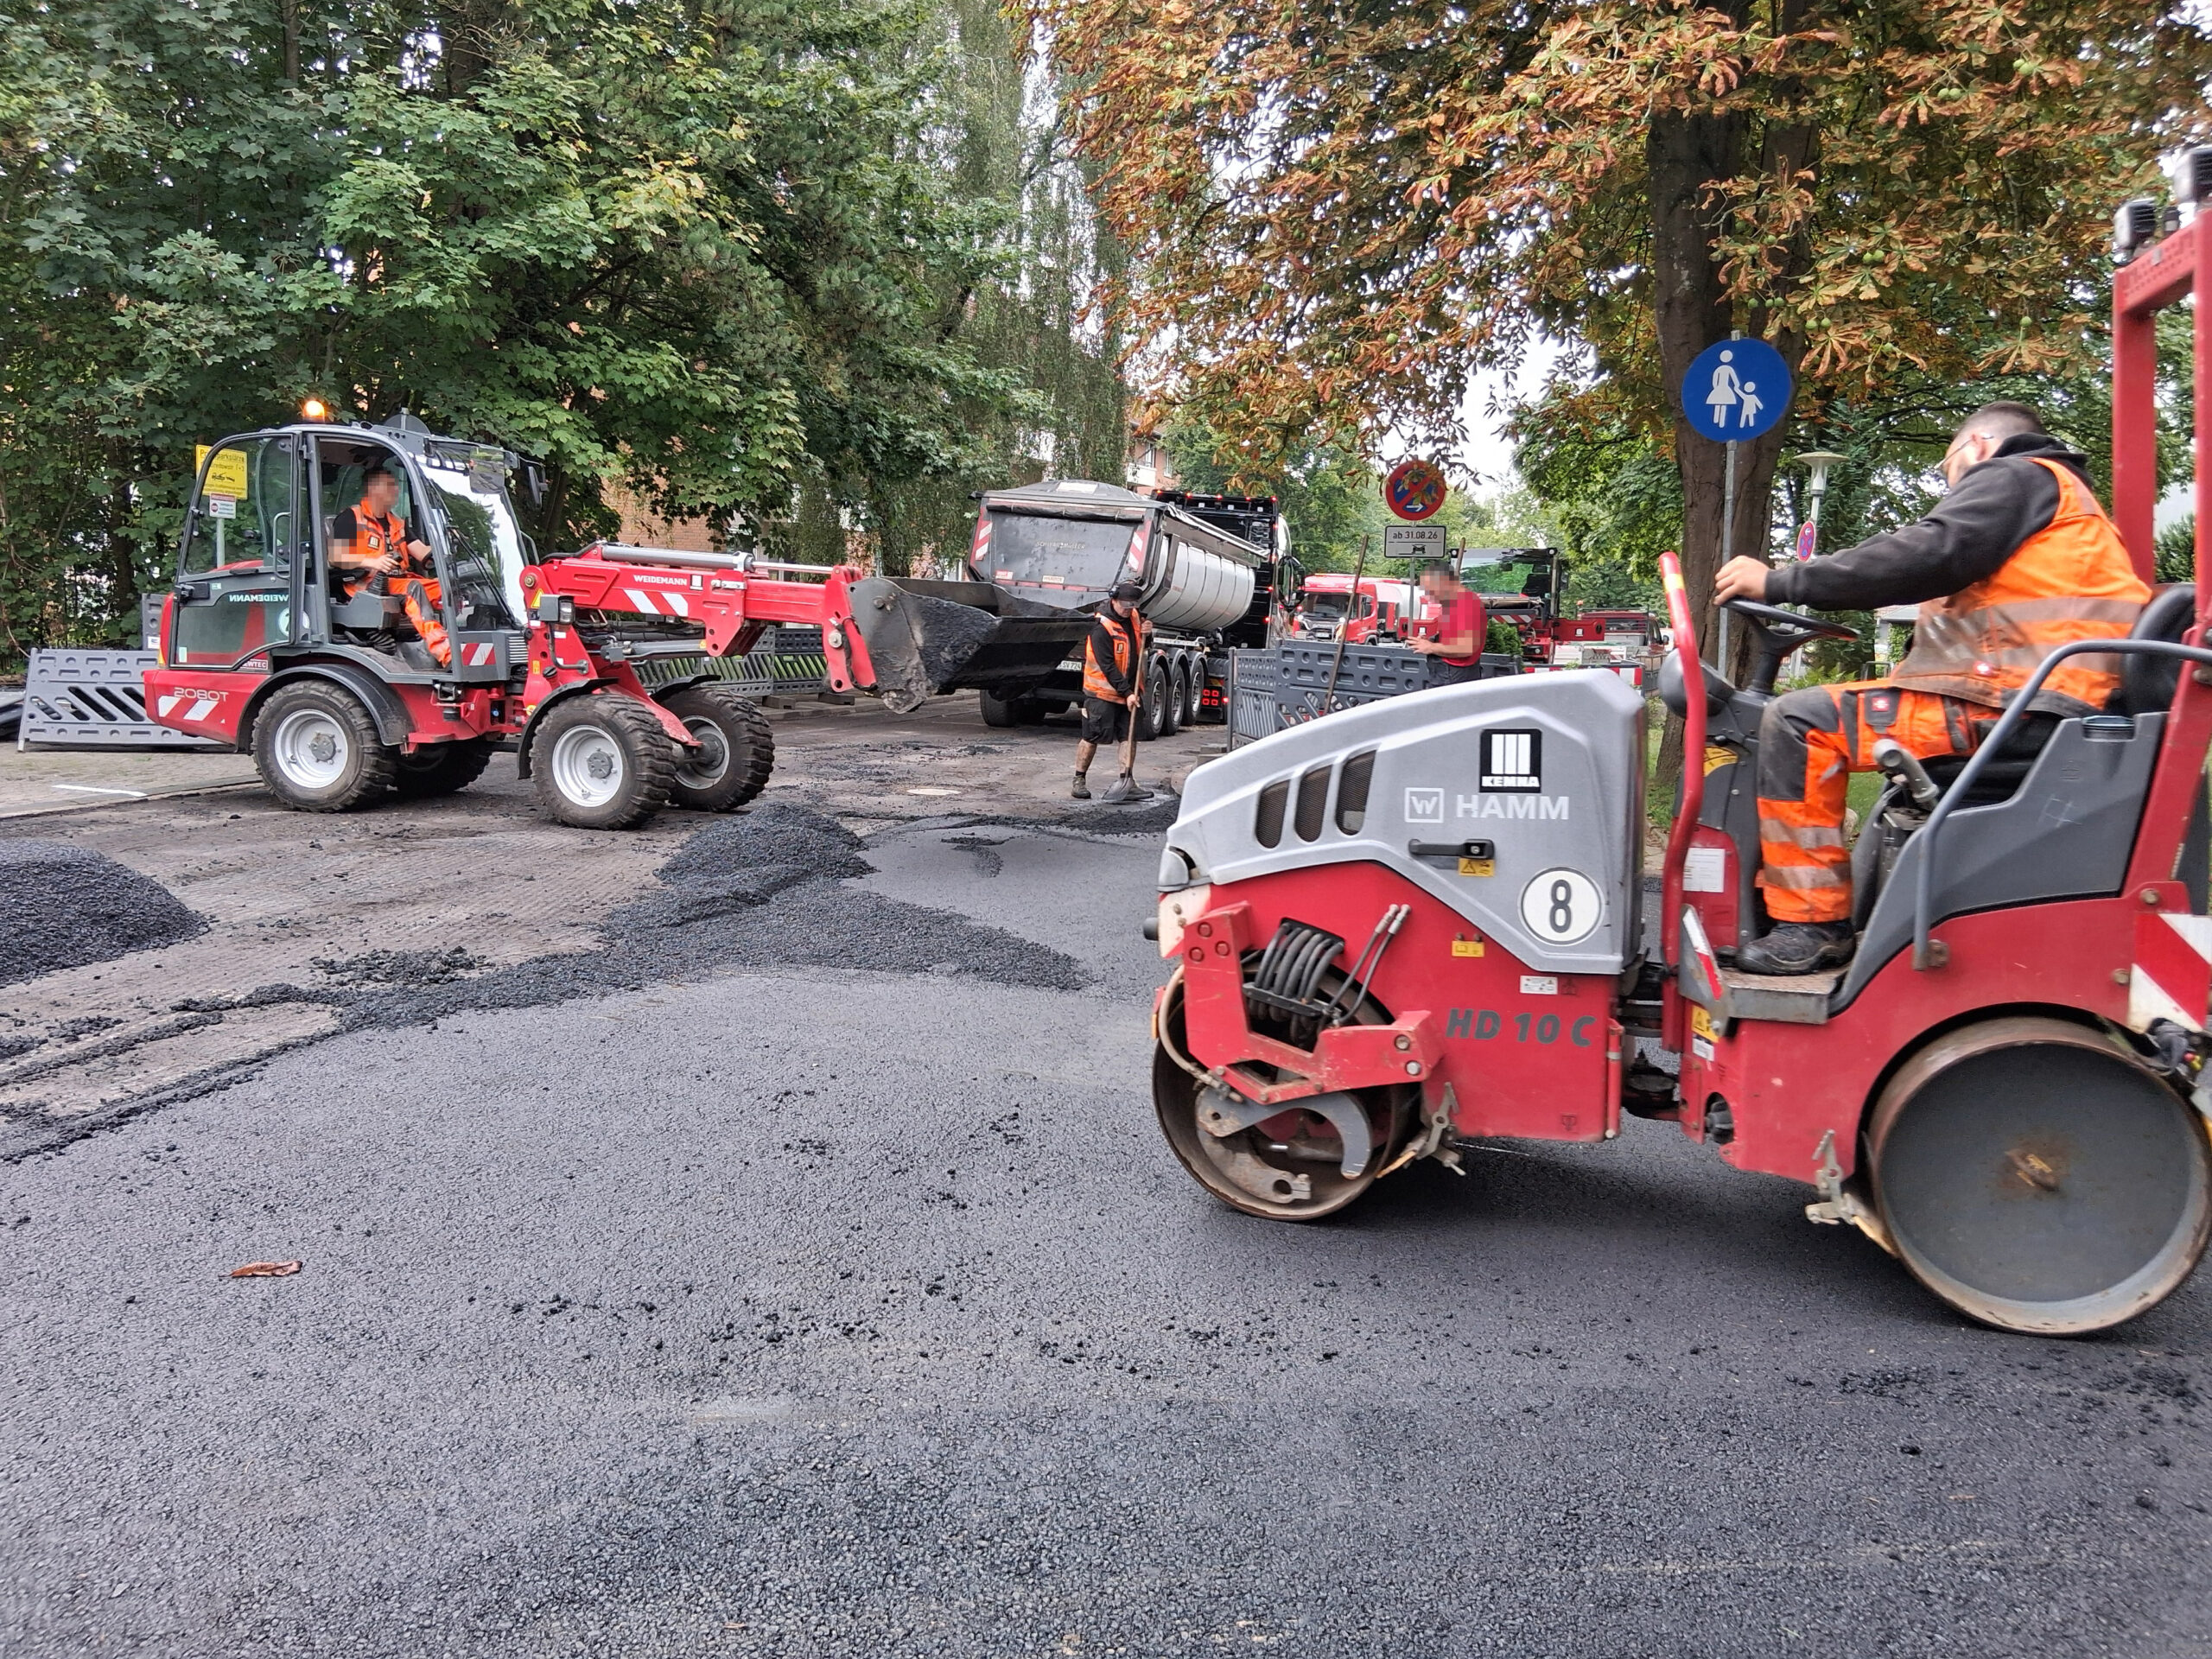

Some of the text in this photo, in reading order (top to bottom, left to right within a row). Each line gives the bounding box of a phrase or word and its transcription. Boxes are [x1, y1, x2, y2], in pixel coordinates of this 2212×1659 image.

[1392, 531, 1439, 540] ab 31.08.26
[632, 574, 688, 586] WEIDEMANN
[173, 687, 229, 702] 2080T
[1457, 794, 1570, 820] HAMM
[1549, 879, 1572, 934] 8
[1445, 1007, 1597, 1047] HD 10 C
